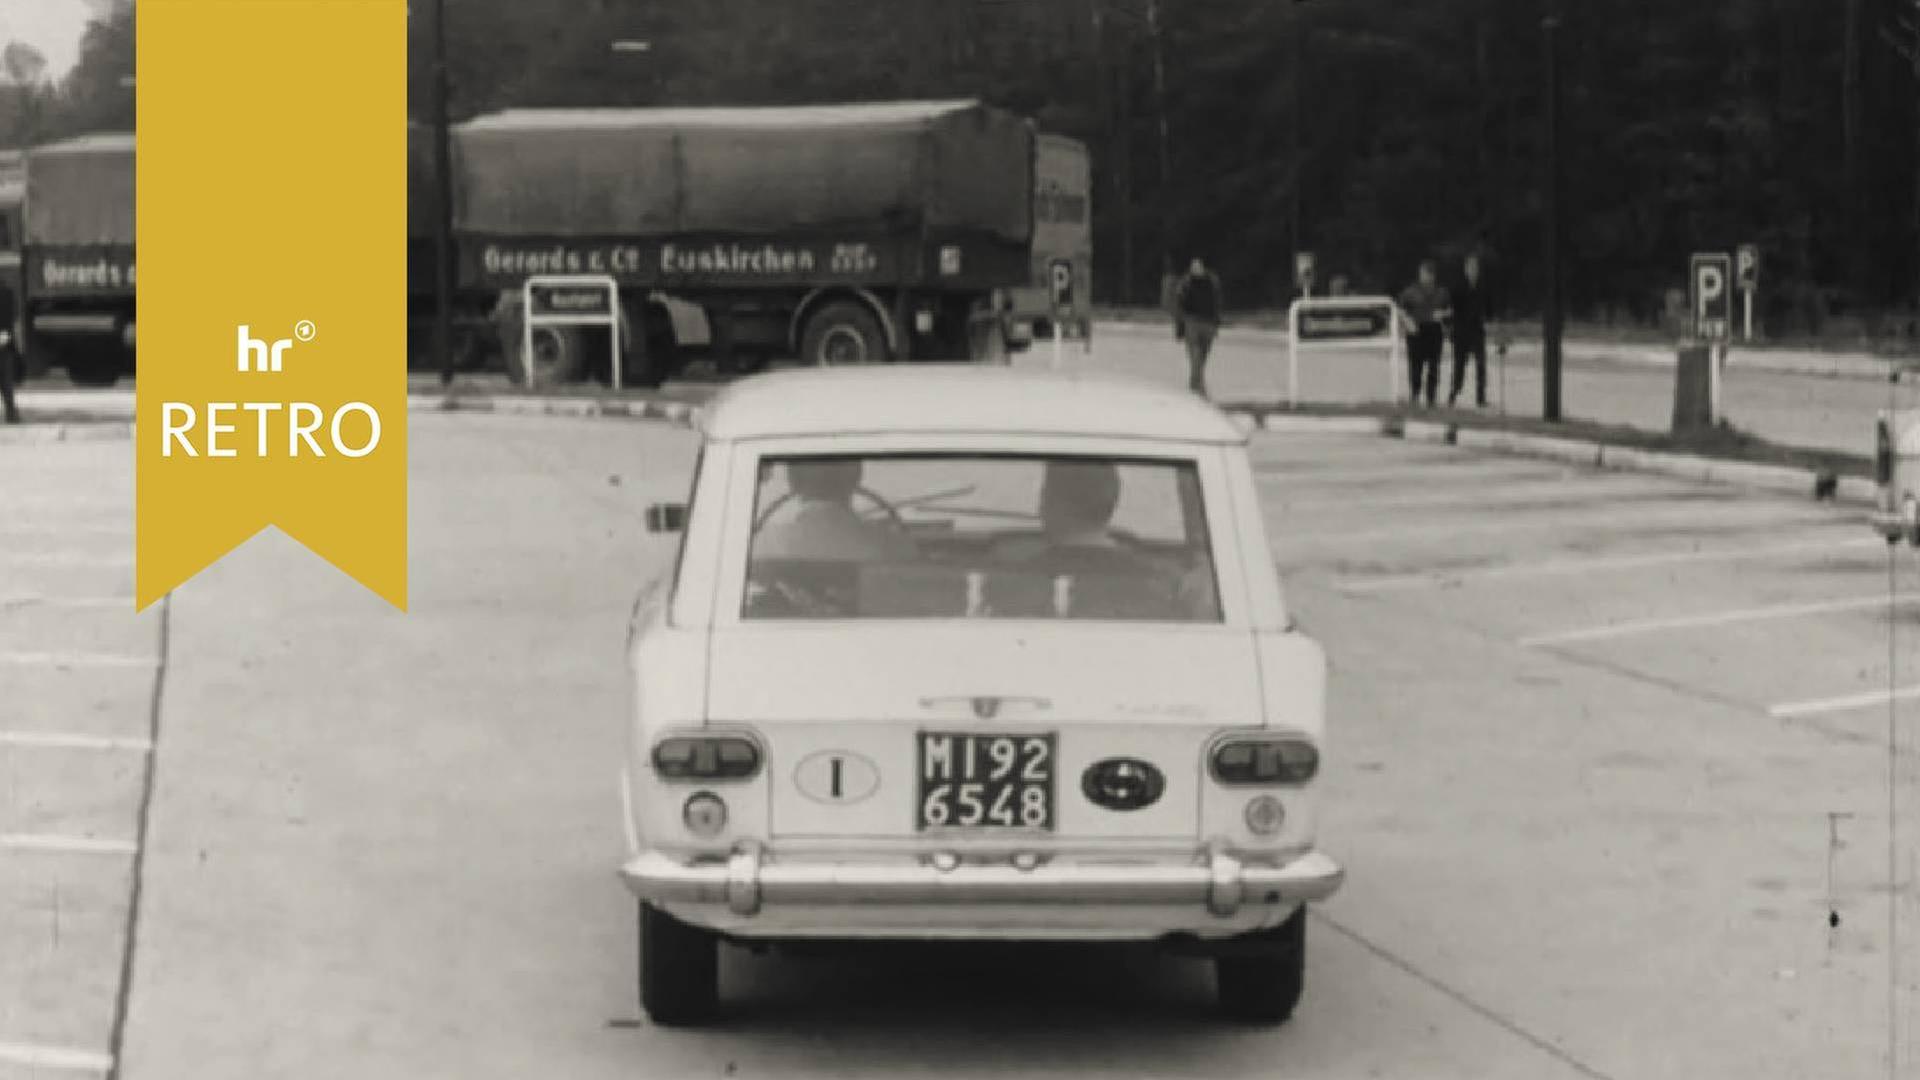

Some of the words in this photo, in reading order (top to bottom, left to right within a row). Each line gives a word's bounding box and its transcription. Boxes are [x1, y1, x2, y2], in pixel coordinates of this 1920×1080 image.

[661, 245, 815, 273] Euskirchen
[1698, 266, 1722, 317] P
[830, 757, 844, 797] I
[924, 784, 1048, 826] 6548
